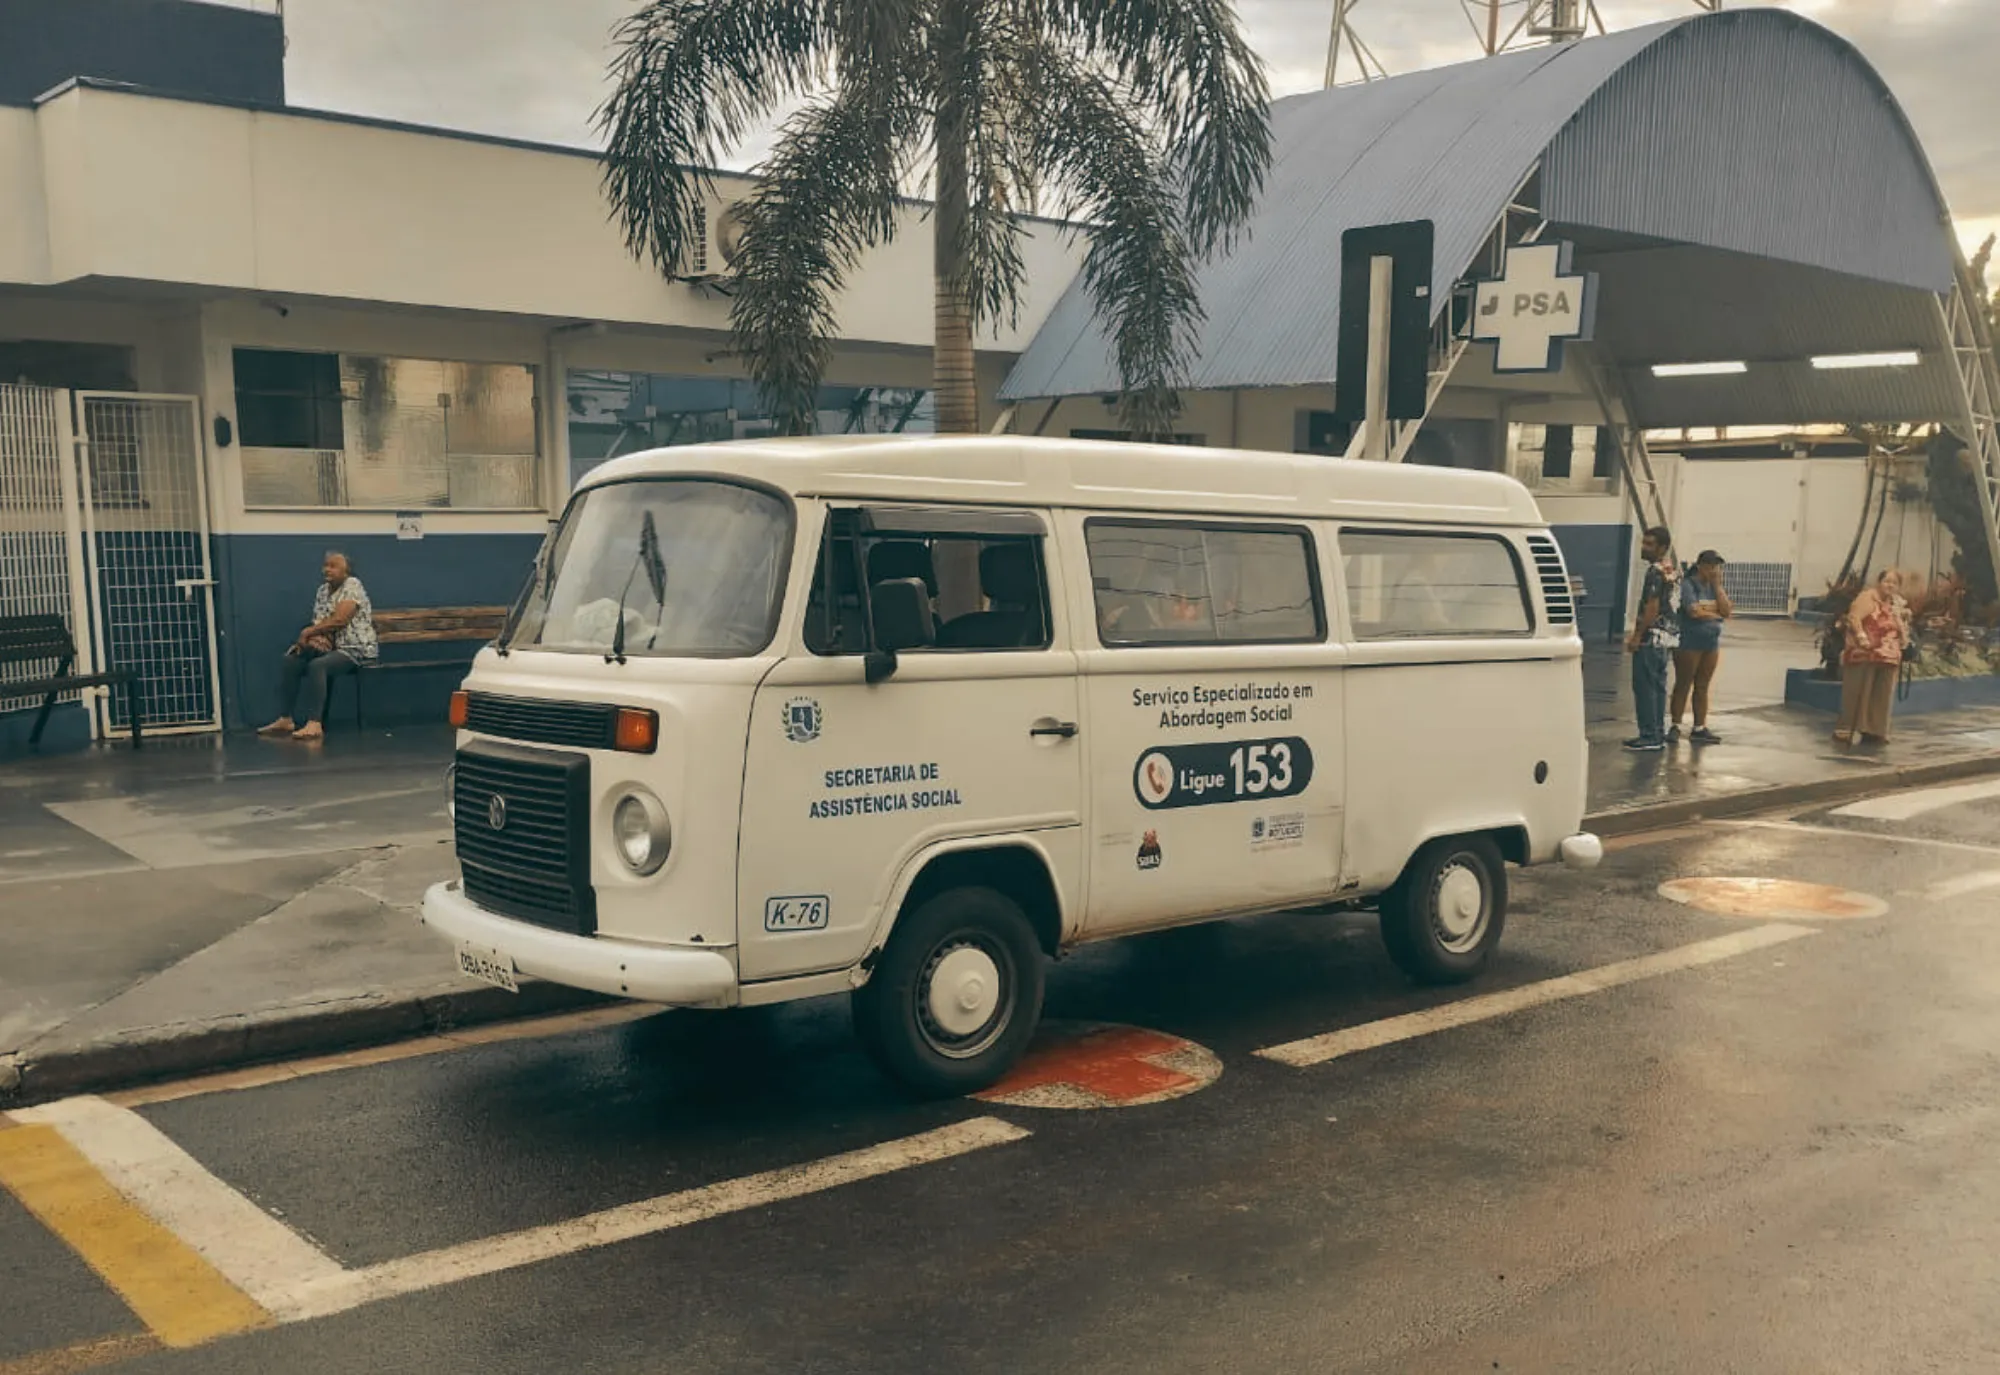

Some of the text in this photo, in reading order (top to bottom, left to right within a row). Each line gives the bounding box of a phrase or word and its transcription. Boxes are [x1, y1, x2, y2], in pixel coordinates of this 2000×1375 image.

[1513, 291, 1570, 318] PSA
[1133, 681, 1313, 710] Serviço Especializado em
[1160, 704, 1293, 730] Abordagem Social
[825, 763, 940, 788] SECRETARIA DE
[1180, 742, 1293, 795] Ligue 153
[912, 789, 962, 809] SOCIAL
[771, 902, 822, 925] K-76
